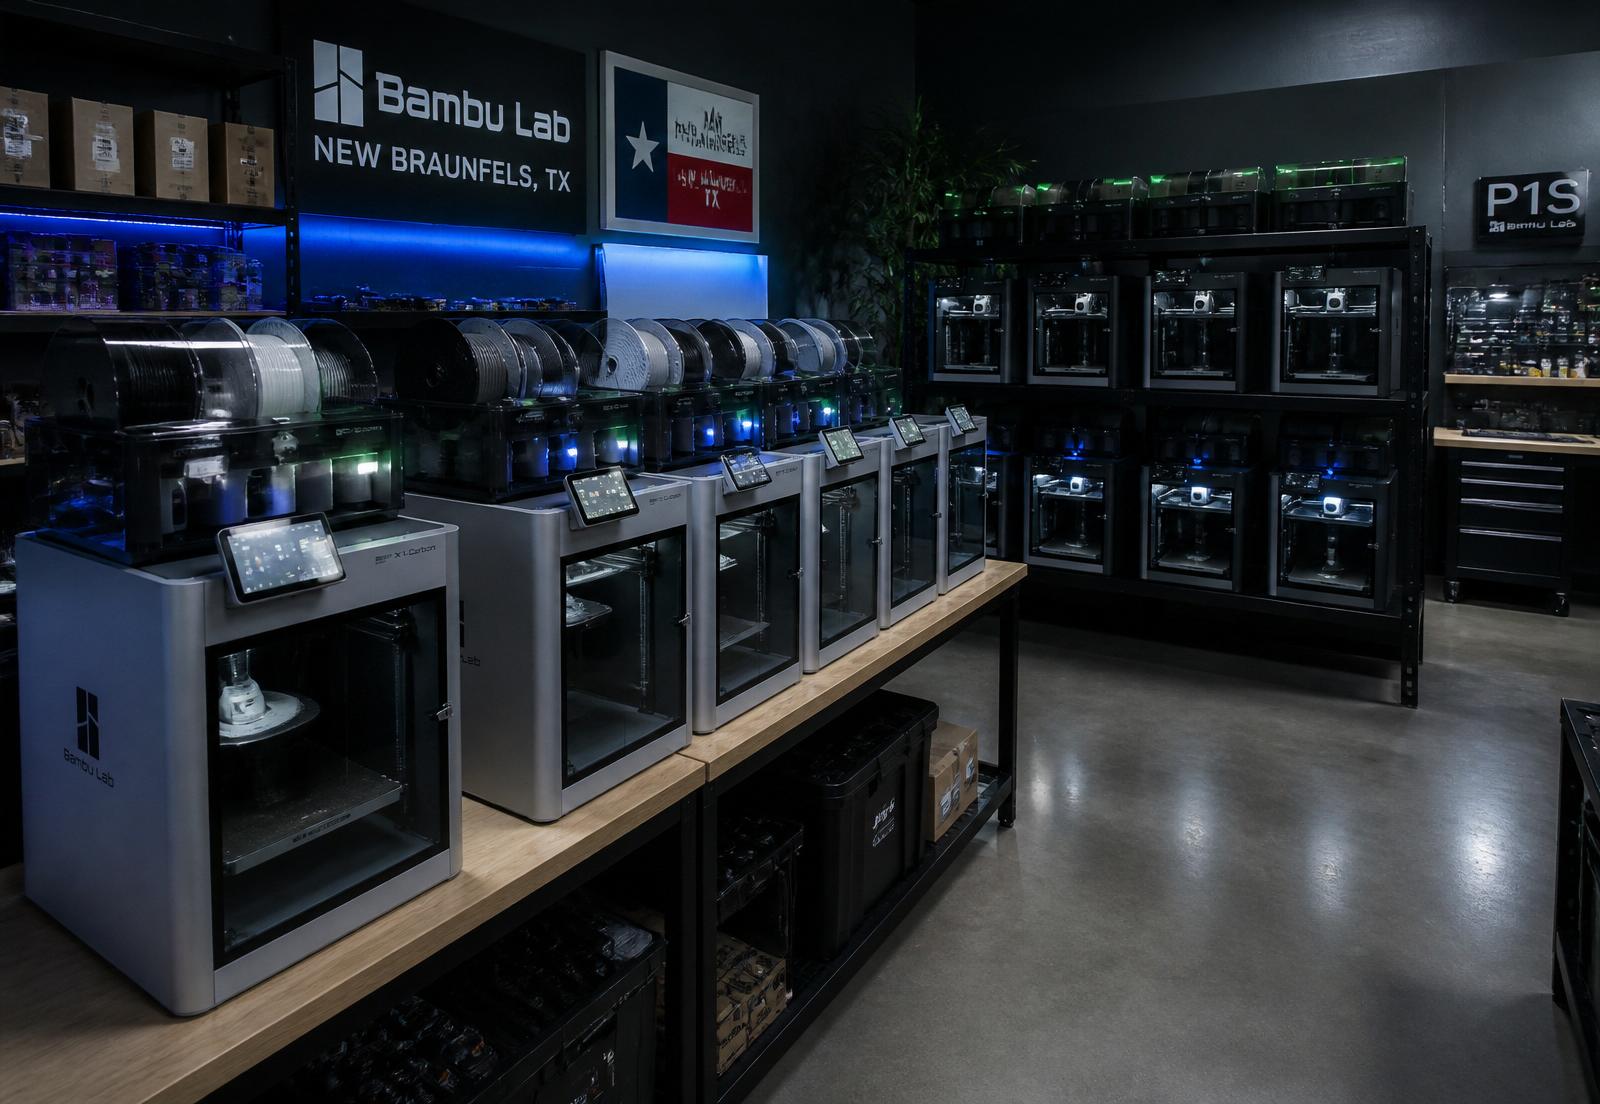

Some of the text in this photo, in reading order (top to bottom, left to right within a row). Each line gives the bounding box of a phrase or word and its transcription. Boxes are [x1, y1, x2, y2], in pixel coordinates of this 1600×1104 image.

[375, 71, 571, 143] Bambu Lab
[314, 134, 571, 192] NEW BRAUNFELS, TX
[1487, 179, 1580, 217] P1S
[96, 767, 114, 788] Lab
